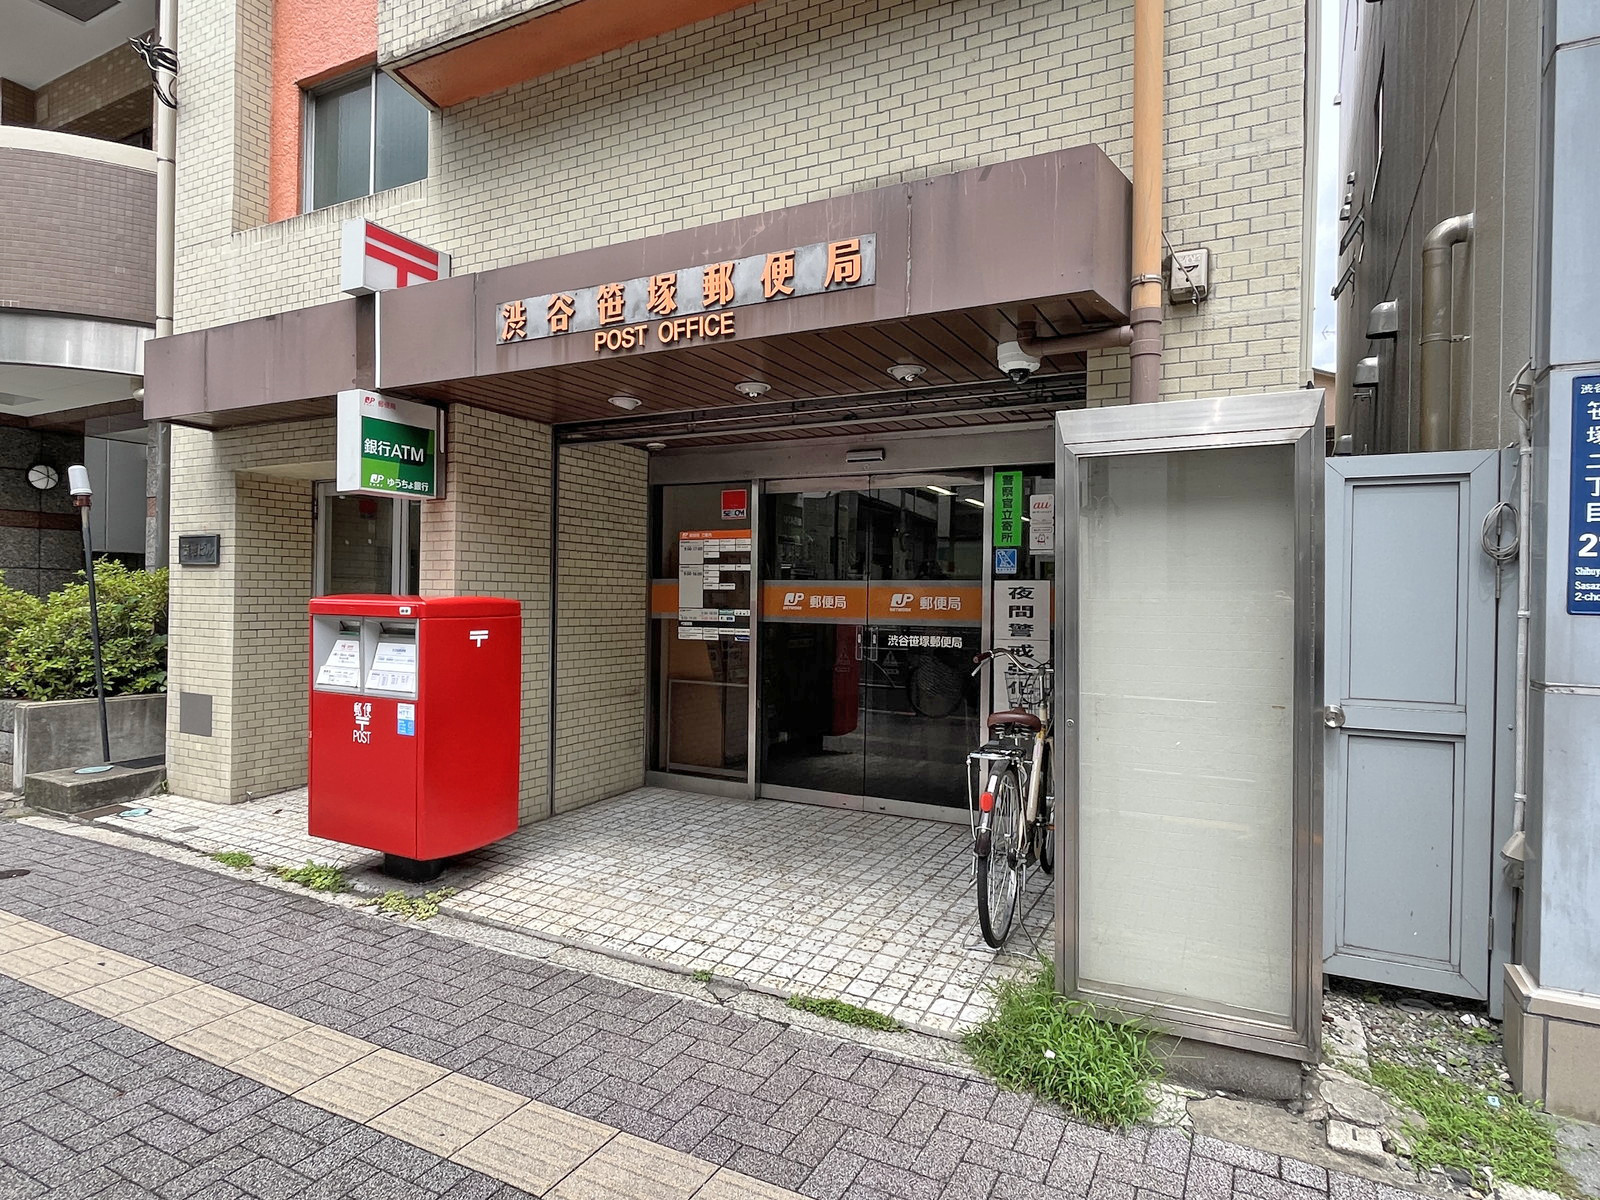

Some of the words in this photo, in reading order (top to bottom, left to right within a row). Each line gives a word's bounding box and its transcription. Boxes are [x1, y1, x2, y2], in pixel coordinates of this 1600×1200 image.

[501, 238, 862, 341] 渋谷笹塚郵便局
[594, 324, 649, 352] POST
[657, 311, 735, 344] OFFICE
[364, 438, 424, 463] 銀行ATM
[386, 478, 429, 492] ゆうちょ銀行
[723, 509, 745, 517] SEOM
[1001, 474, 1014, 543] 警察官立寄所
[1033, 501, 1051, 510] au
[809, 595, 847, 609] 郵便局
[919, 596, 961, 611] 郵便局
[887, 634, 963, 649] 渋谷笹塚郵便局
[353, 702, 372, 718] 郵便
[353, 729, 372, 744] POST
